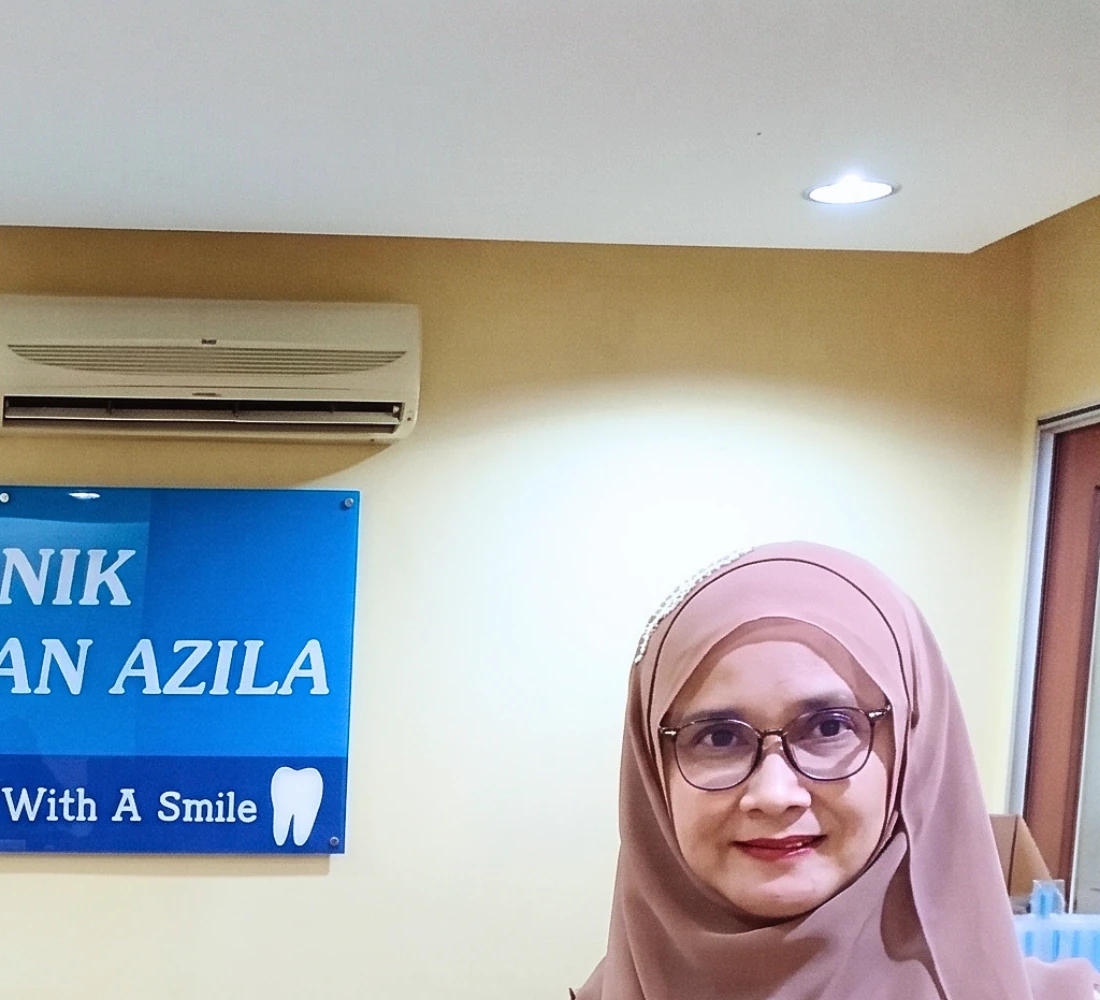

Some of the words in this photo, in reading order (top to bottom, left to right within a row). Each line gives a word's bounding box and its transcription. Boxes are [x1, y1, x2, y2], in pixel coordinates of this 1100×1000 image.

[108, 638, 331, 695] AZILA
[1, 786, 99, 823] With
[111, 789, 143, 823] A
[158, 791, 258, 823] Smile
